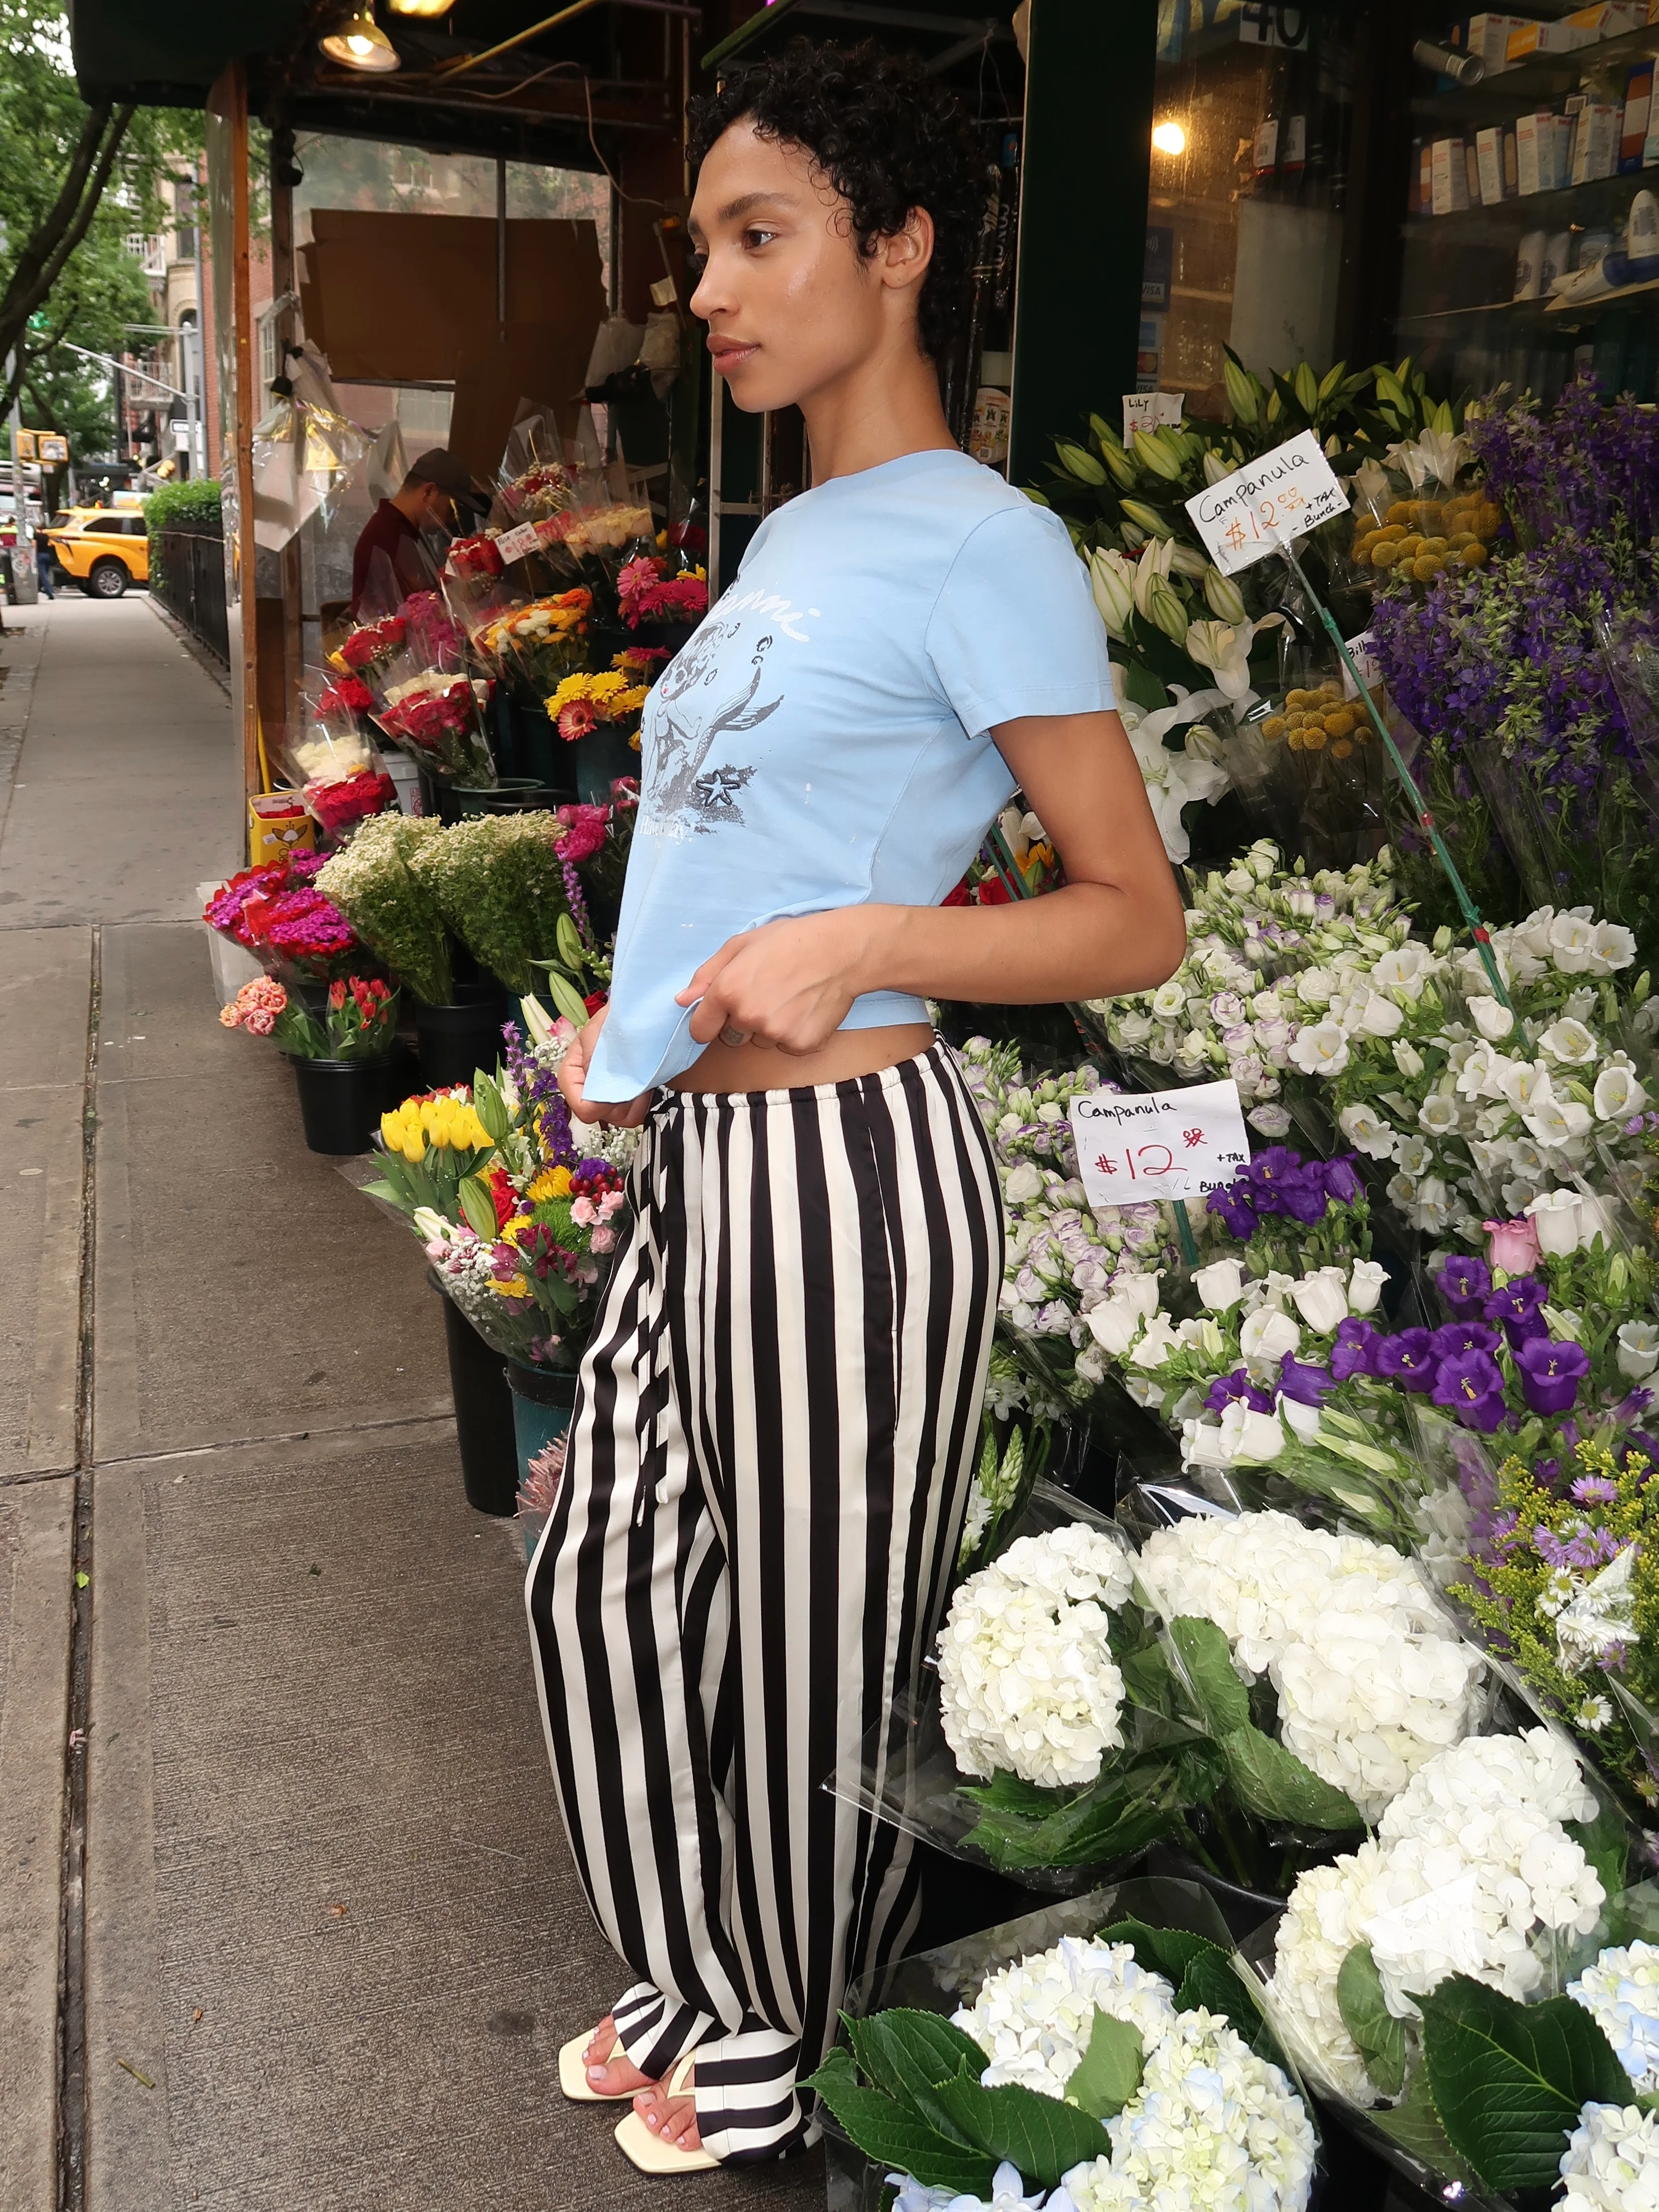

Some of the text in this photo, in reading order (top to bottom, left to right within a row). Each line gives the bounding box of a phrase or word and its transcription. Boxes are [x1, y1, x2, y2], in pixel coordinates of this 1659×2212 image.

[1199, 453, 1309, 523] Campanula
[1304, 503, 1336, 528] Bunch
[1078, 1096, 1178, 1125] Campanula
